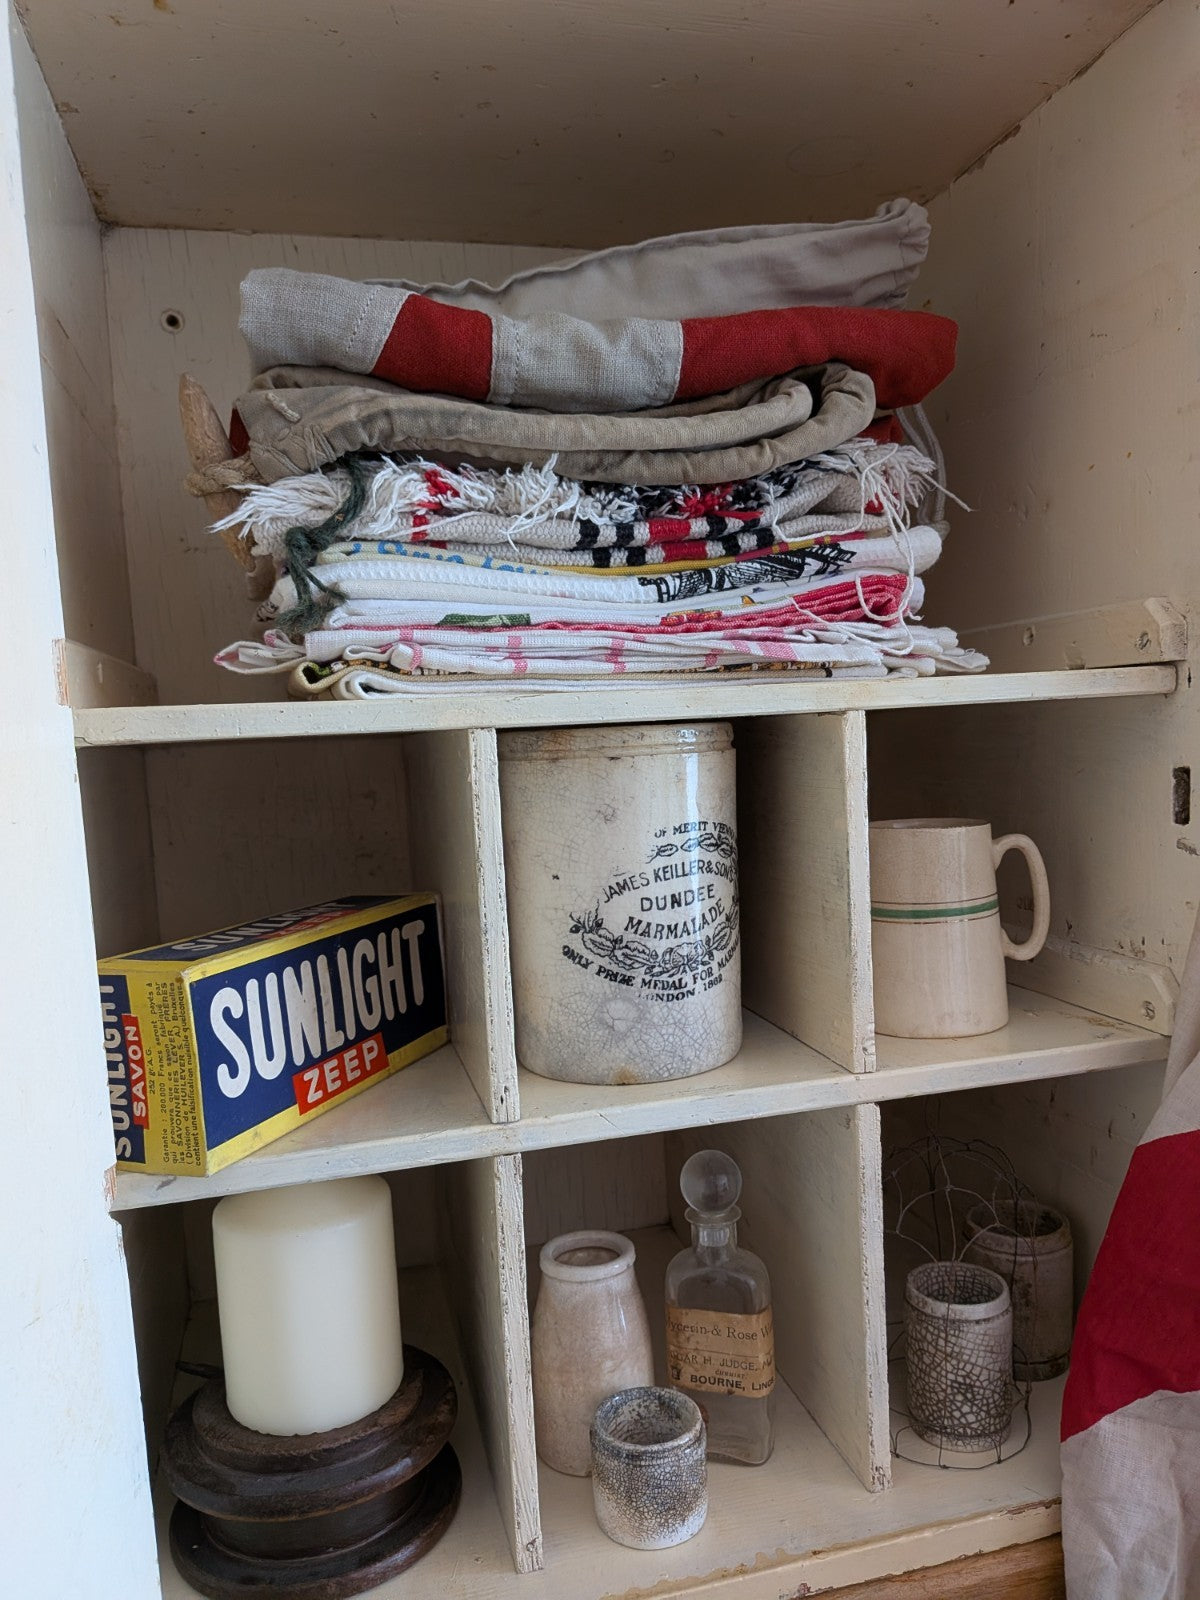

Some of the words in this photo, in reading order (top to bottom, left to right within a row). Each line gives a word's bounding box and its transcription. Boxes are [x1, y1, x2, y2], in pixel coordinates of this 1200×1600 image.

[673, 821, 708, 835] MERIT
[603, 872, 650, 903] JAMES
[640, 884, 715, 912] DUNDEE
[624, 898, 726, 941] MARMALADE
[562, 945, 595, 970] ONLY
[595, 965, 635, 987] PRIZE
[640, 977, 687, 991] MEDAL
[692, 966, 714, 985] FOR
[169, 982, 178, 1021] Bruxelles
[210, 920, 425, 1098] SUNLIGHT
[151, 1021, 161, 1045] seront
[168, 1030, 178, 1063] LEVER
[183, 1035, 192, 1065] nuisible
[125, 1026, 146, 1117] SAVON
[168, 1072, 172, 1081] ce
[178, 1055, 187, 1105] HUILEVER
[303, 1040, 379, 1104] ZEEP
[173, 1070, 183, 1146] SAVONNERIES
[187, 1069, 196, 1114] falsification
[169, 1108, 177, 1144] prouvera
[183, 1111, 188, 1121] de
[170, 1152, 178, 1164] qui
[192, 1133, 201, 1166] contient
[726, 1326, 758, 1341] Rose
[720, 1358, 758, 1372] JUDGE,
[690, 1374, 746, 1391] BOURNE,
